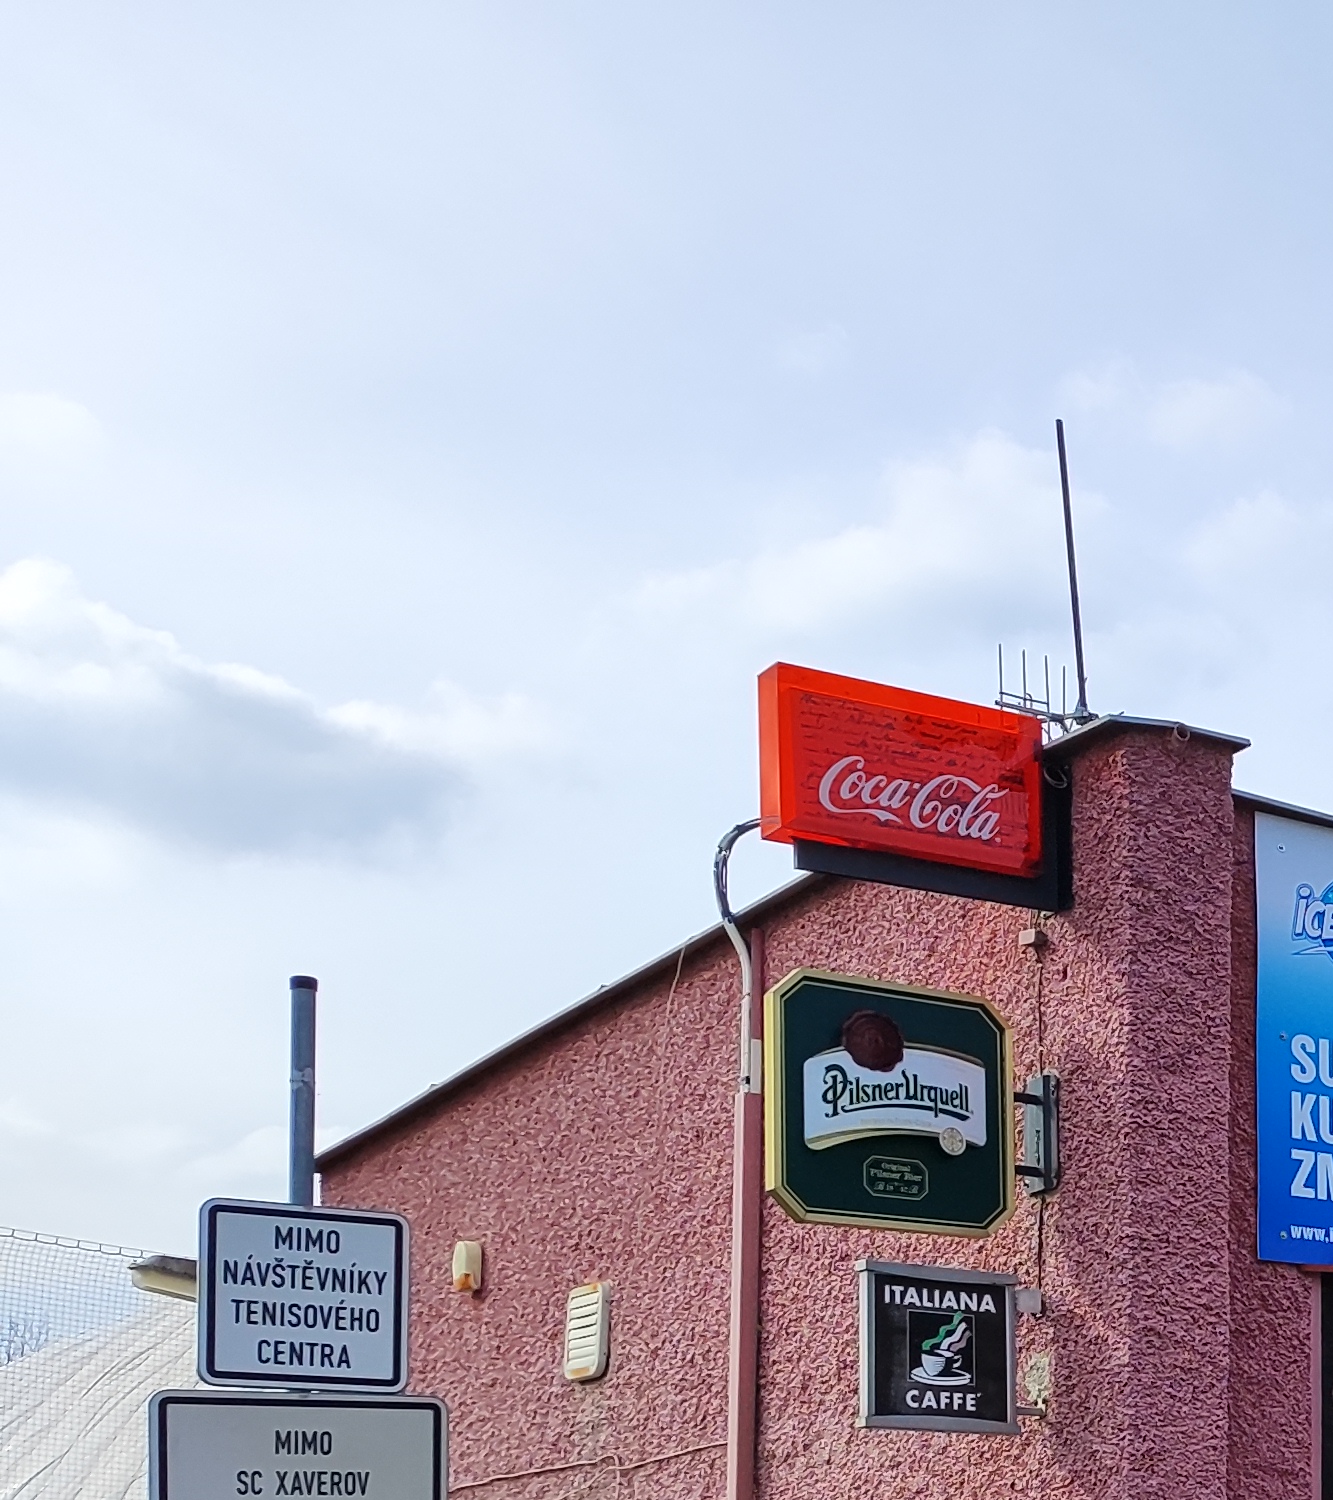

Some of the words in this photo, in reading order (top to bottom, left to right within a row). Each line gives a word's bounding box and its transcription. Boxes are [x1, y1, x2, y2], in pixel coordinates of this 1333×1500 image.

[818, 755, 1009, 842] Coca-Cola
[822, 1063, 903, 1118] Pilsner
[901, 1069, 972, 1118] Urquell
[274, 1225, 340, 1255] MIMO
[222, 1254, 388, 1296] NÁVŠTĚVNÍKY
[884, 1284, 996, 1314] ITALIANA
[231, 1299, 380, 1333] TENISOVÉHO
[257, 1339, 351, 1369] CENTRA
[274, 1430, 332, 1456] MIMO
[236, 1470, 262, 1495] SC
[275, 1471, 370, 1496] XAVEROV
